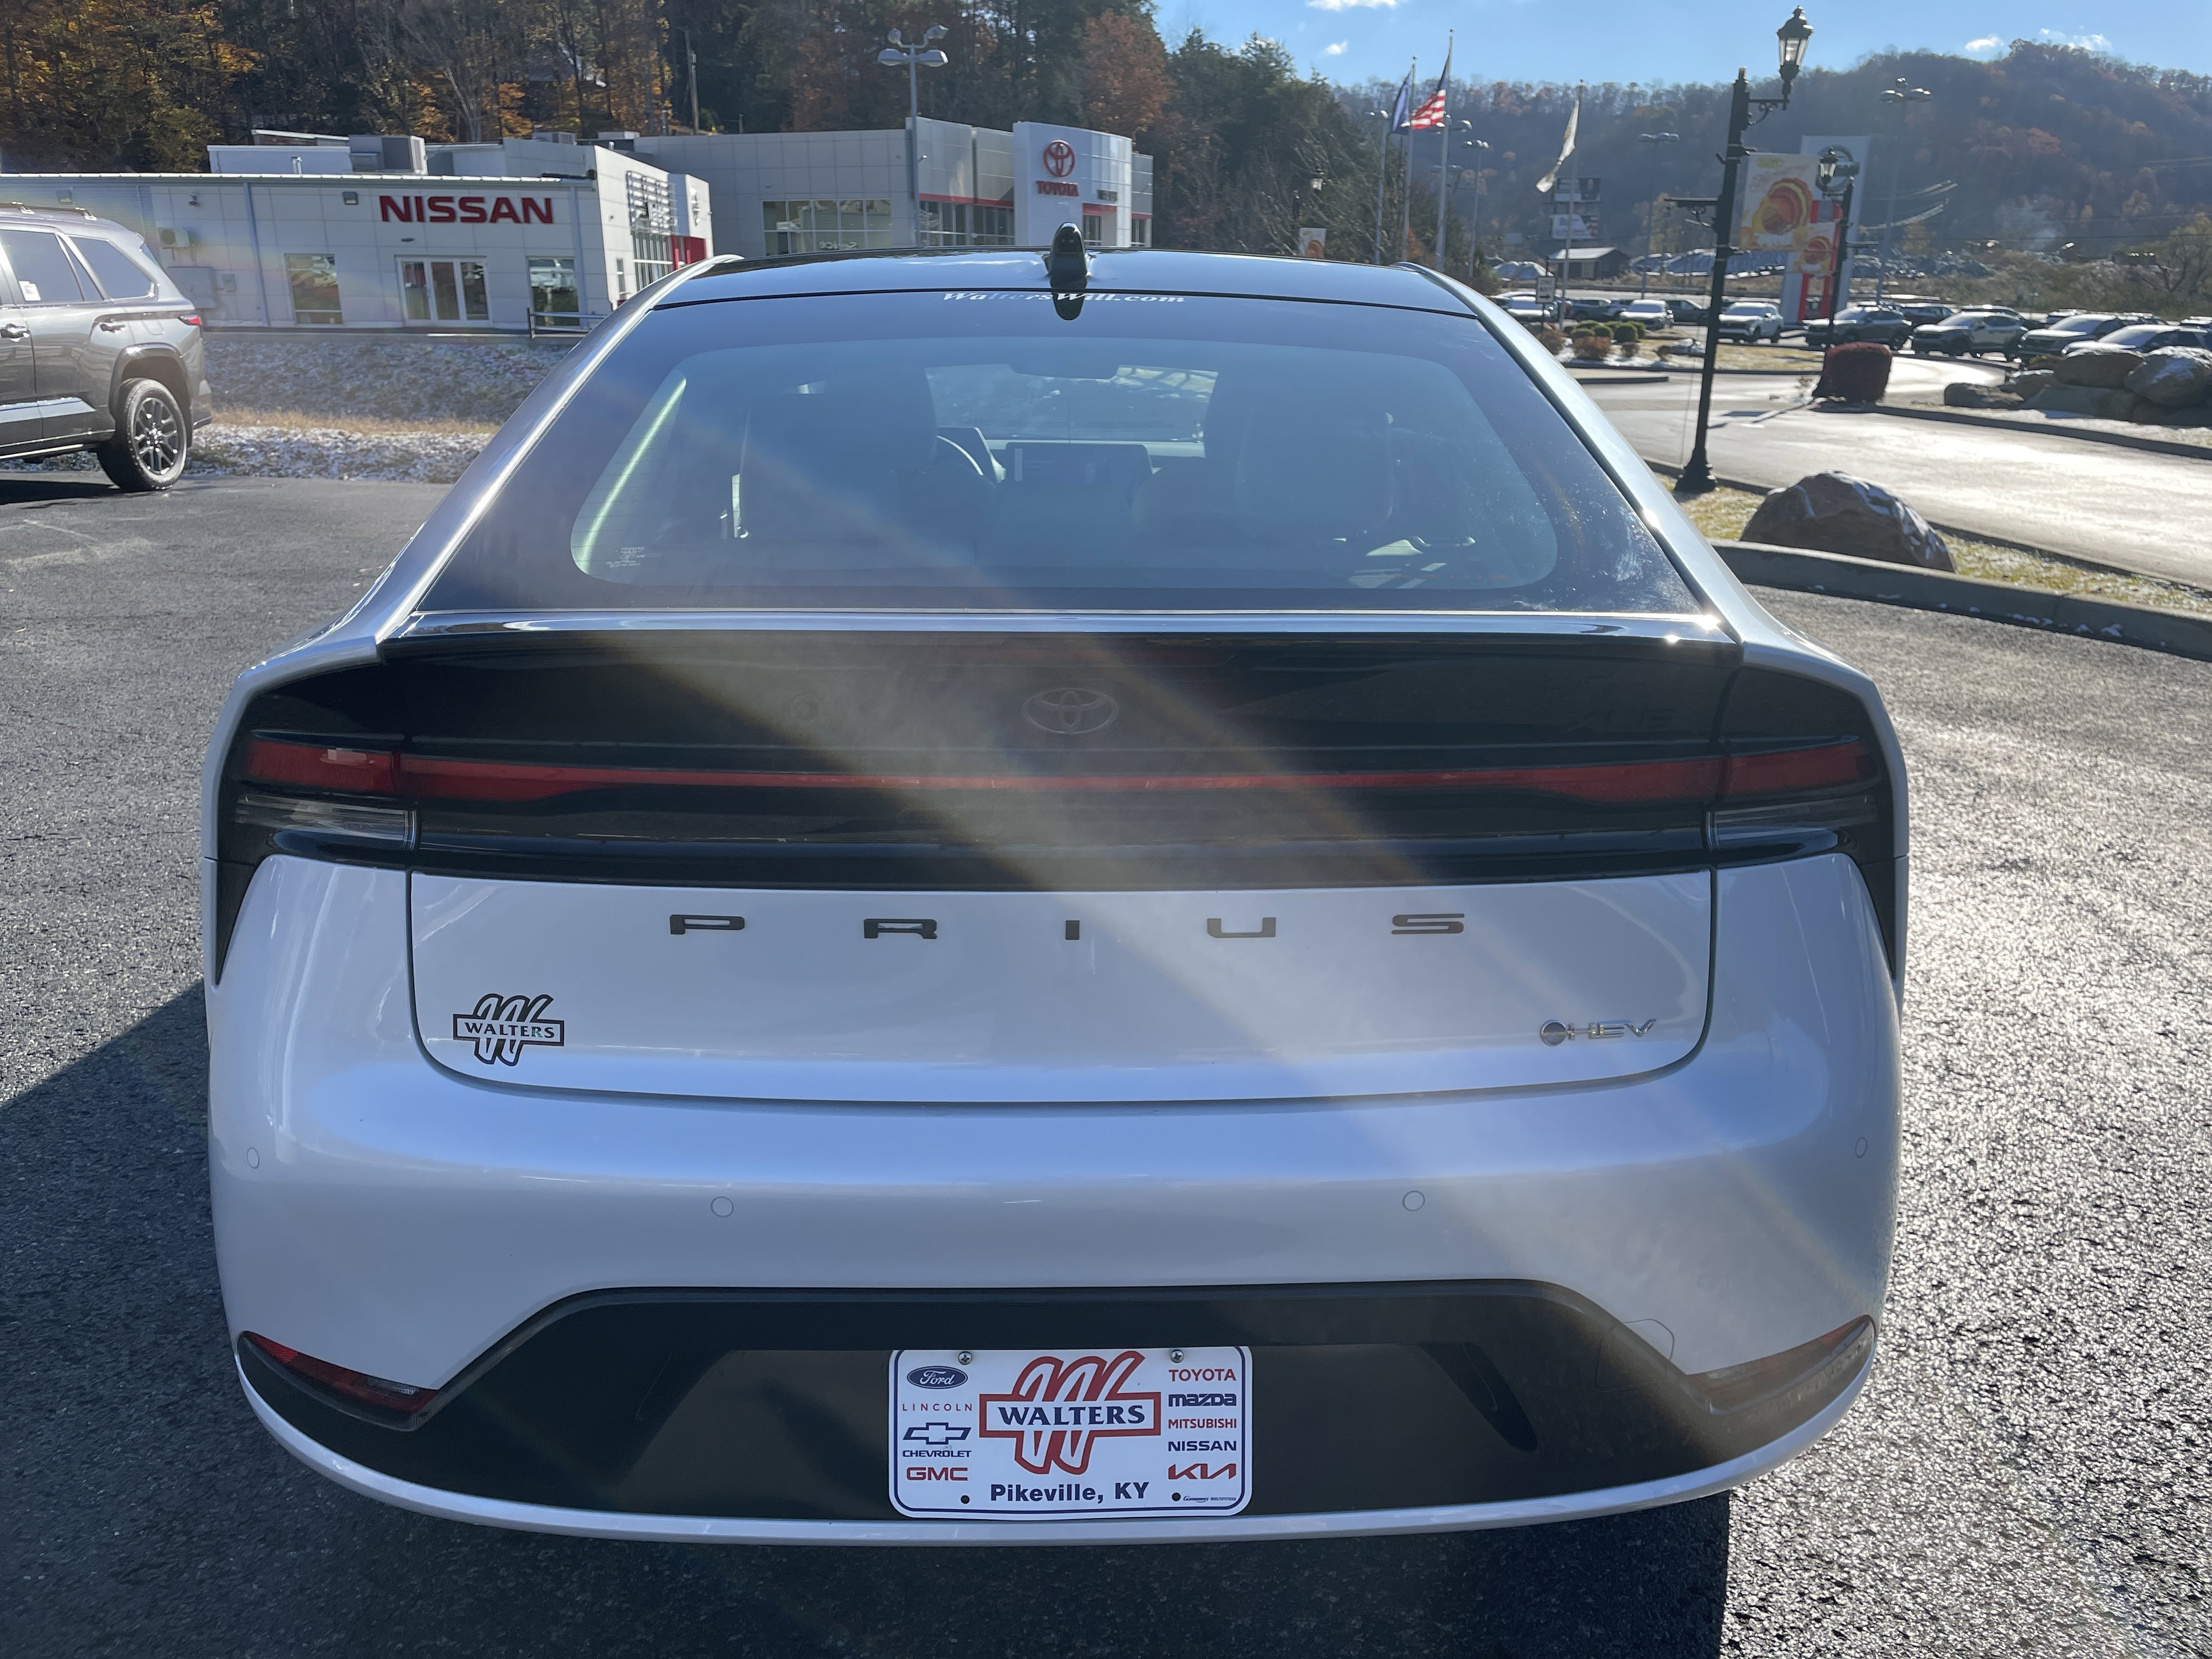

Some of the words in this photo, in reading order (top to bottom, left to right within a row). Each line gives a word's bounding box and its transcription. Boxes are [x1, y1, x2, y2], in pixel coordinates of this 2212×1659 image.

[1036, 180, 1079, 197] TOYOTA
[379, 195, 554, 224] NISSAN
[943, 292, 1186, 303] WaltersWill.com
[669, 913, 1465, 940] PRIUS
[464, 1022, 555, 1039] WALTERS
[1567, 1018, 1658, 1040] HEV
[919, 1370, 955, 1385] Ford
[1169, 1368, 1237, 1382] TOYOTA
[997, 1405, 1145, 1425] WALTERS
[1168, 1418, 1237, 1429] MITSUBISHI
[1168, 1440, 1237, 1452] NISSAN
[906, 1467, 968, 1481] GMC
[1168, 1463, 1237, 1480] KIA
[990, 1483, 1103, 1504] Pikeville,
[1115, 1482, 1149, 1500] KY
